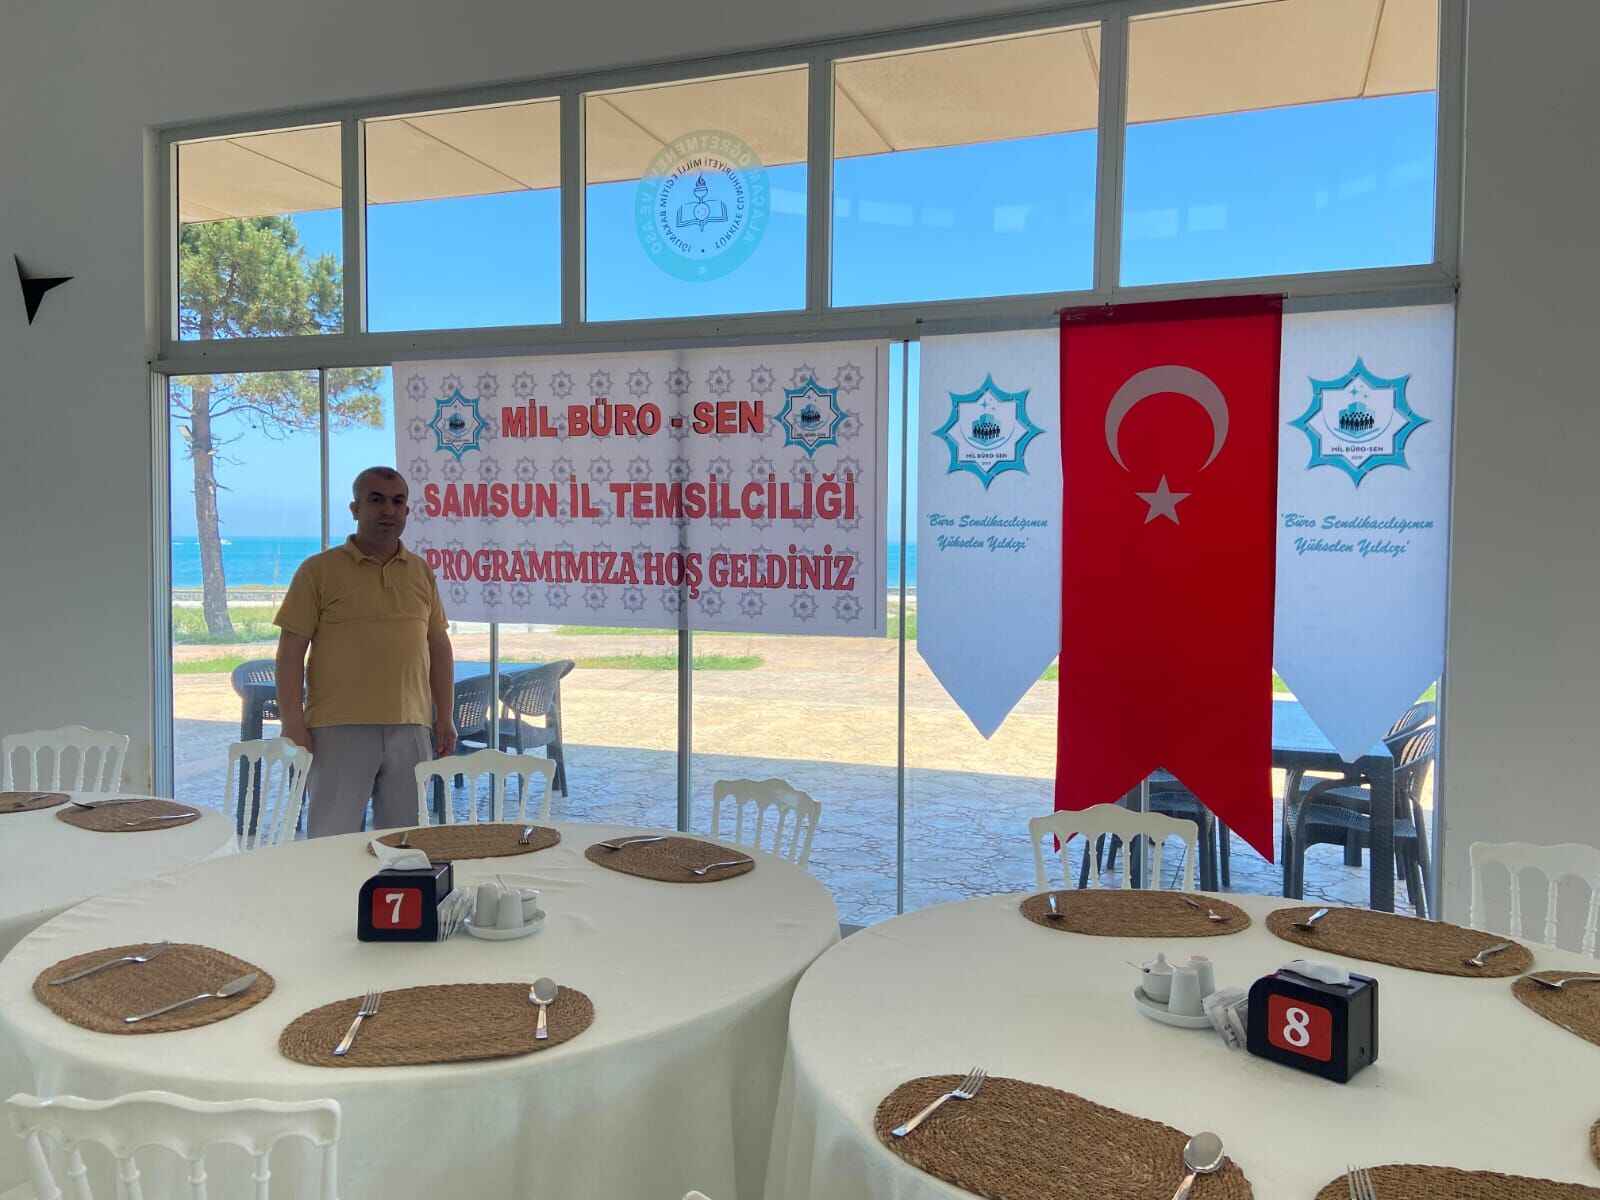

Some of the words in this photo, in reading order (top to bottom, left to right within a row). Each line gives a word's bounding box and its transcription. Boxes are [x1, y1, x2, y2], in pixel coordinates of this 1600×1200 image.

[502, 398, 558, 438] MİL
[567, 397, 662, 437] BÜRO
[692, 400, 764, 435] SEN
[424, 482, 557, 518] SAMSUN
[569, 474, 600, 518] İL
[609, 473, 855, 520] TEMSİLCİLİĞİ
[425, 548, 639, 585] PROGRAMIMIZA
[643, 552, 703, 600] HOŞ
[708, 544, 855, 591] GELDİNİZ
[385, 892, 405, 924] 7
[1282, 1007, 1311, 1048] 8
